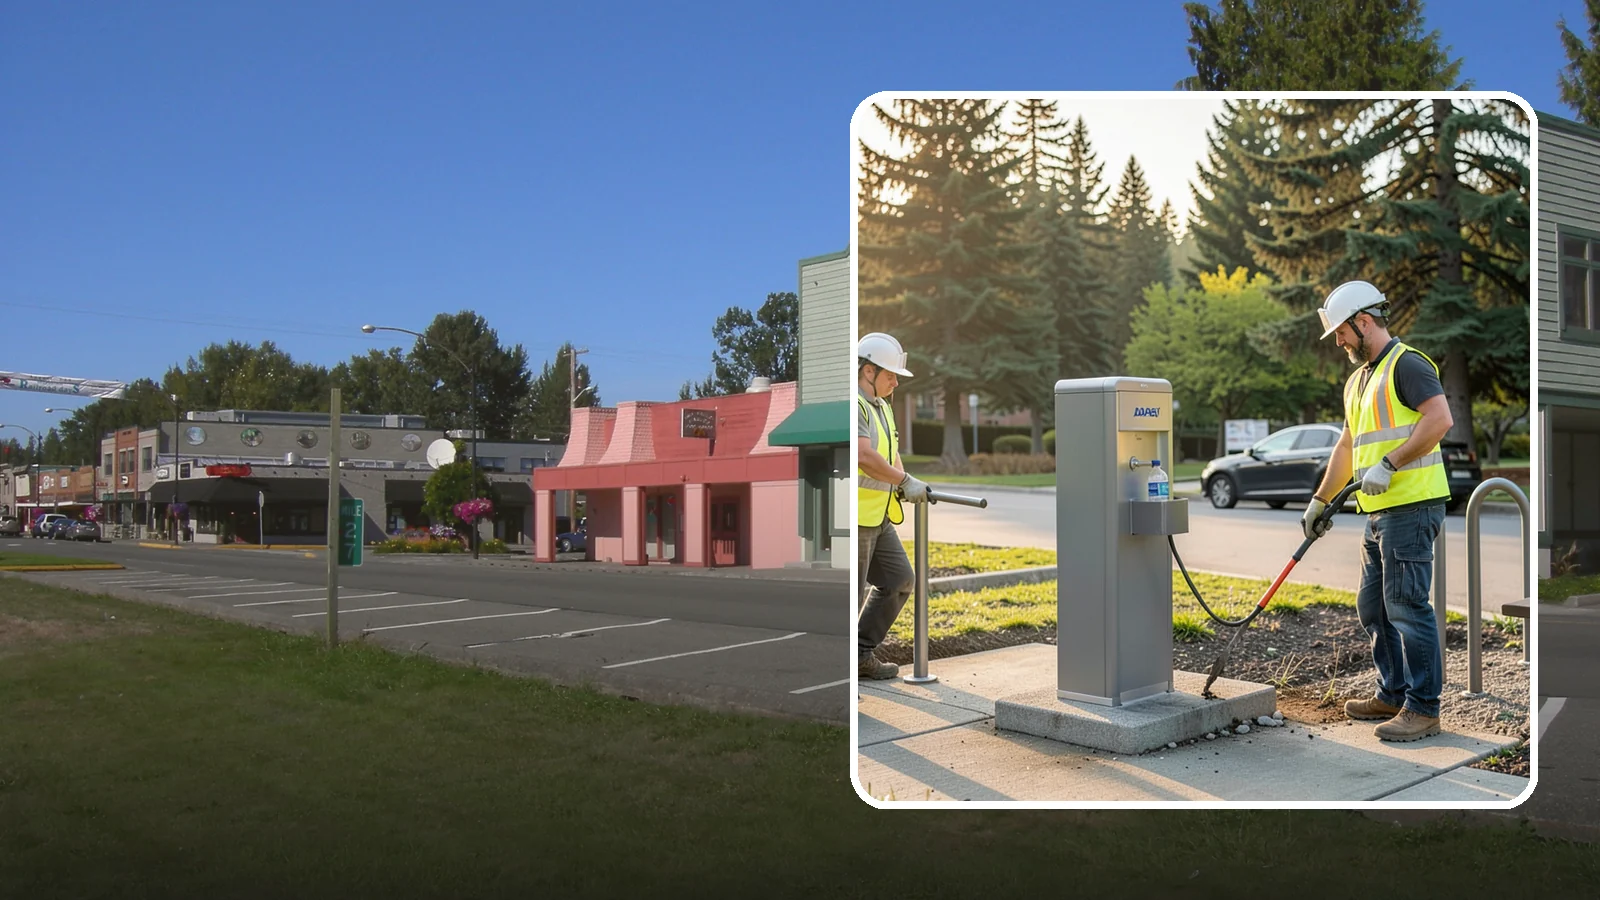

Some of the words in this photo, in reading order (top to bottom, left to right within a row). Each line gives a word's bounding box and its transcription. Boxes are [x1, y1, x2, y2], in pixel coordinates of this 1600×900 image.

[341, 505, 362, 517] MILE
[344, 522, 357, 539] 2
[344, 543, 356, 560] 7
